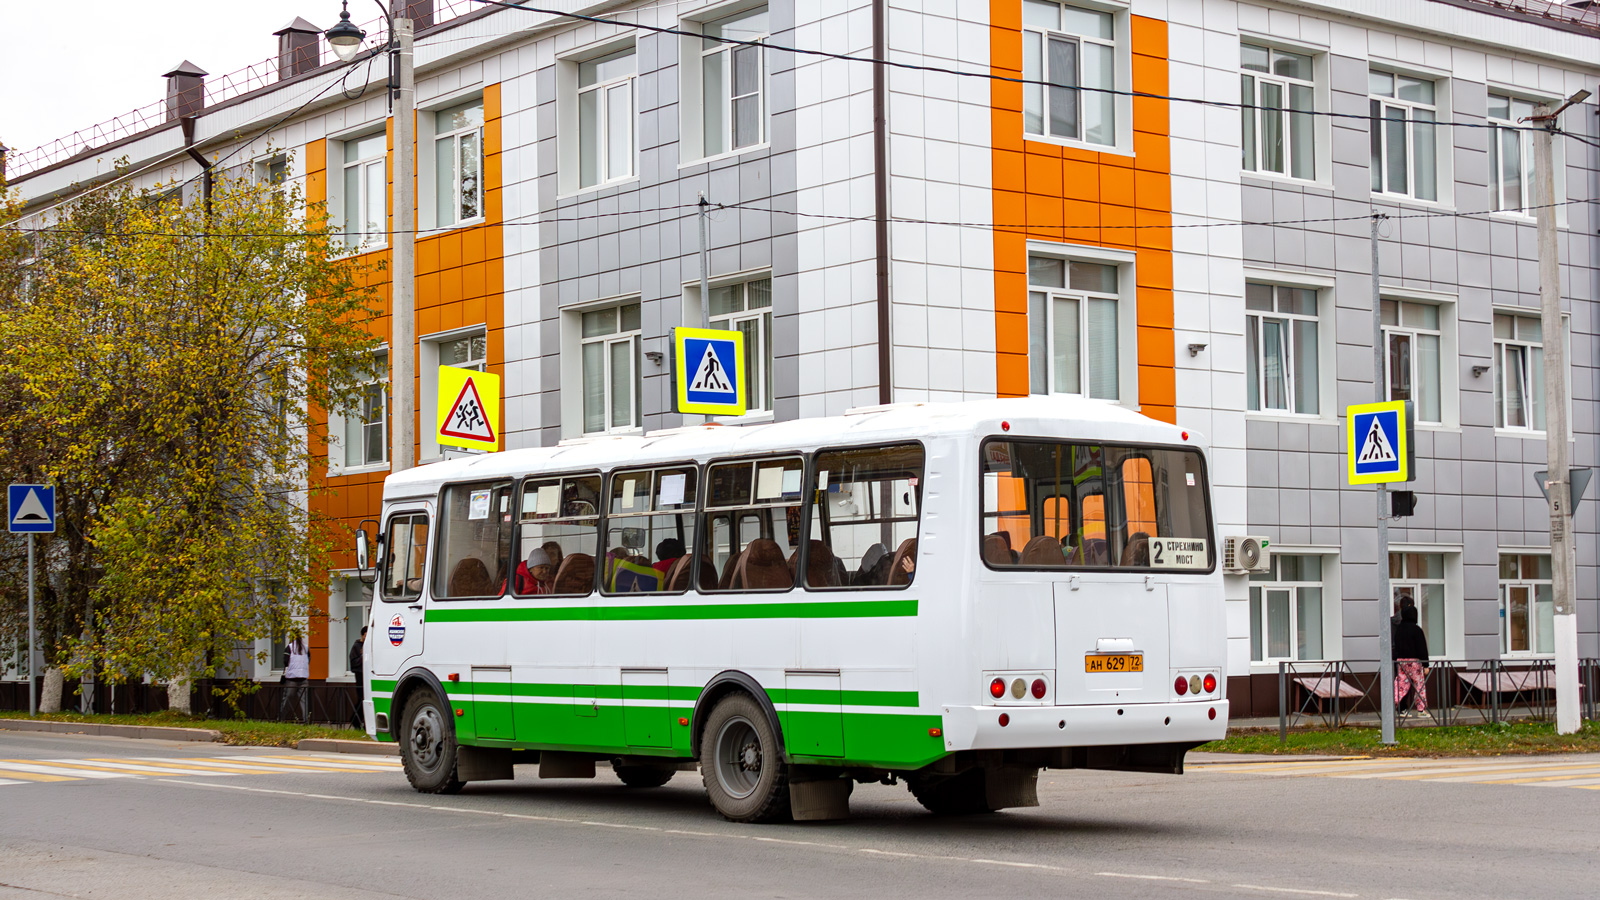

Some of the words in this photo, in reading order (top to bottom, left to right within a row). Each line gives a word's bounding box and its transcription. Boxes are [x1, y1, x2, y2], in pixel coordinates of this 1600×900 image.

[1554, 501, 1559, 511] 5
[1167, 541, 1203, 551] СТРЕХНИНО
[1153, 541, 1164, 563] 2
[1176, 555, 1193, 564] МОСТ
[1090, 660, 1102, 670] АН
[1106, 656, 1125, 670] 629
[1130, 656, 1139, 666] 72
